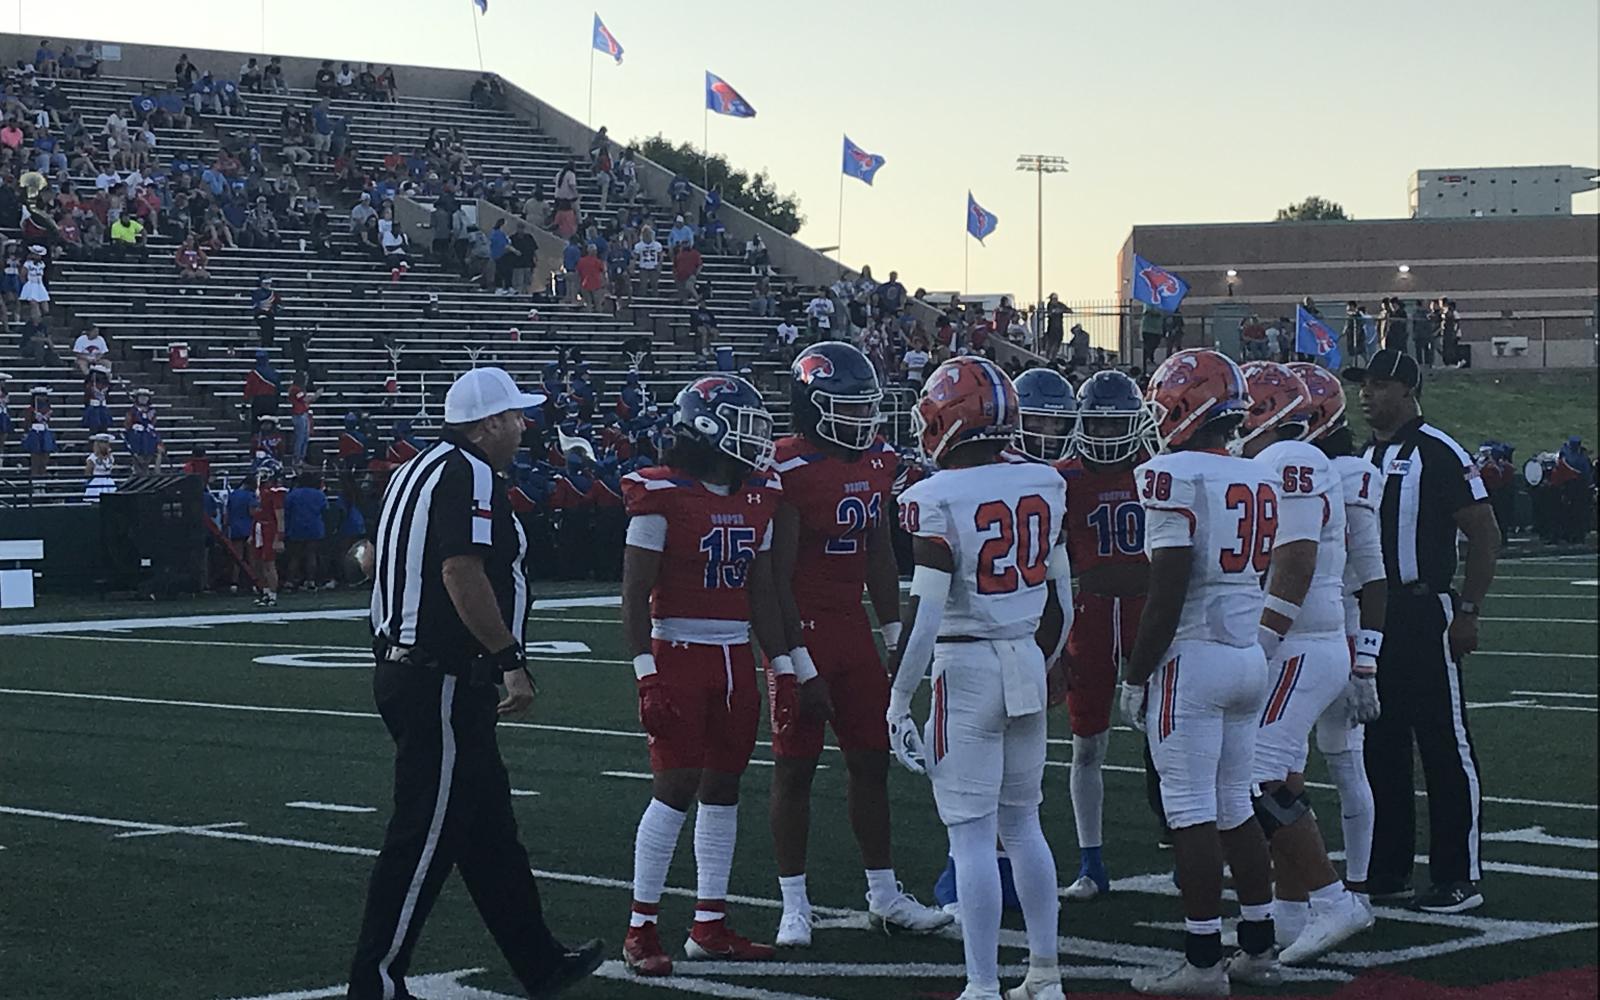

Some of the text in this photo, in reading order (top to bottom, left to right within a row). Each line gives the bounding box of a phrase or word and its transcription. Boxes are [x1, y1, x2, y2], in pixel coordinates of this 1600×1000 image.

[1143, 470, 1172, 501] 38
[1282, 465, 1314, 493] 65
[1359, 472, 1371, 498] 1
[825, 492, 882, 554] 21
[973, 493, 1051, 595] 20
[1088, 502, 1145, 556] 10
[1220, 483, 1278, 573] 38
[699, 527, 756, 589] 15
